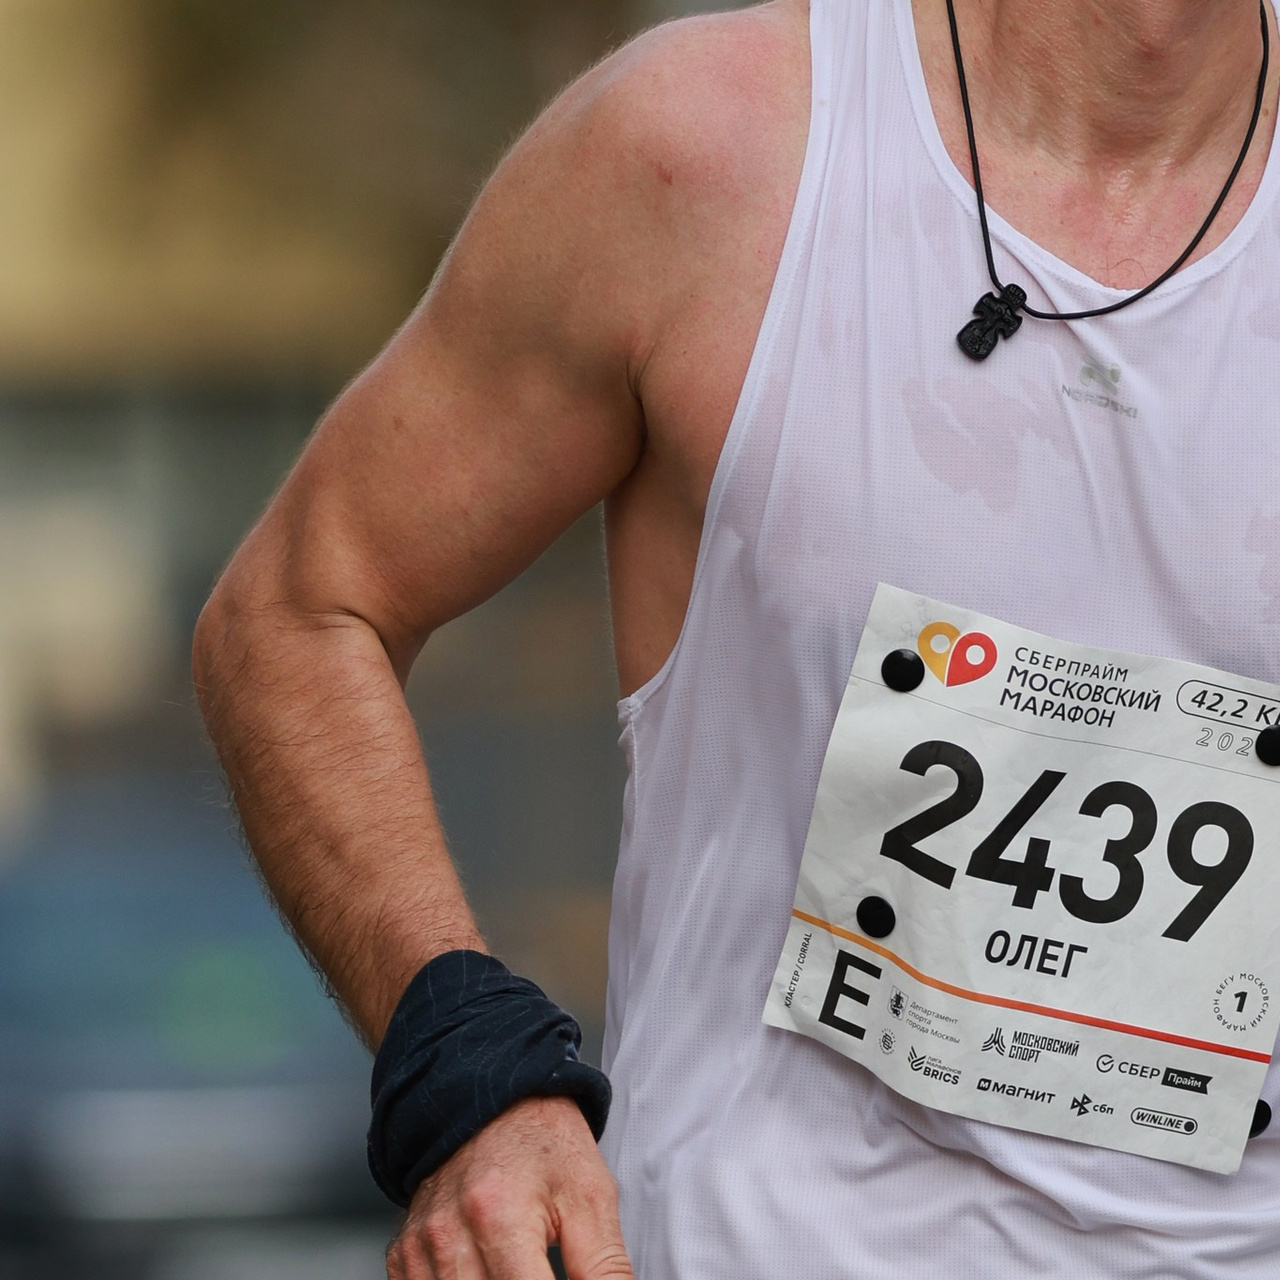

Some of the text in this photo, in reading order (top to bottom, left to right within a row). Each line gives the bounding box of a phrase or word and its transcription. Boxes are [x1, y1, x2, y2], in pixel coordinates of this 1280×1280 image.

[1015, 646, 1129, 683] СБЕРПРАЙМ
[1006, 665, 1162, 713] МОСКОВСКИЙ
[1191, 689, 1248, 718] 42,2
[999, 688, 1116, 728] МАРАФОН
[1195, 727, 1254, 756] 202
[880, 740, 1254, 942] 2439
[984, 929, 1088, 978] ОЛЕГ
[784, 970, 800, 1008] КЛАСТЕР
[797, 932, 812, 964] CORRAL
[818, 949, 882, 1040] E
[1213, 973, 1269, 1031] БЕГУ МОСКОВСКИЙ МАРАФОН
[1234, 991, 1248, 1013] 1
[908, 1010, 932, 1026] спорта
[910, 1001, 958, 1024] Департамент
[906, 1018, 960, 1044] города Москвы
[1012, 1030, 1080, 1057] МОСКОВСКИЙ
[1008, 1045, 1042, 1063] СПОРТ
[923, 1066, 959, 1085] BRICS
[1118, 1061, 1202, 1089] СБЕР Прайм
[1135, 1111, 1184, 1130] WINLINE
